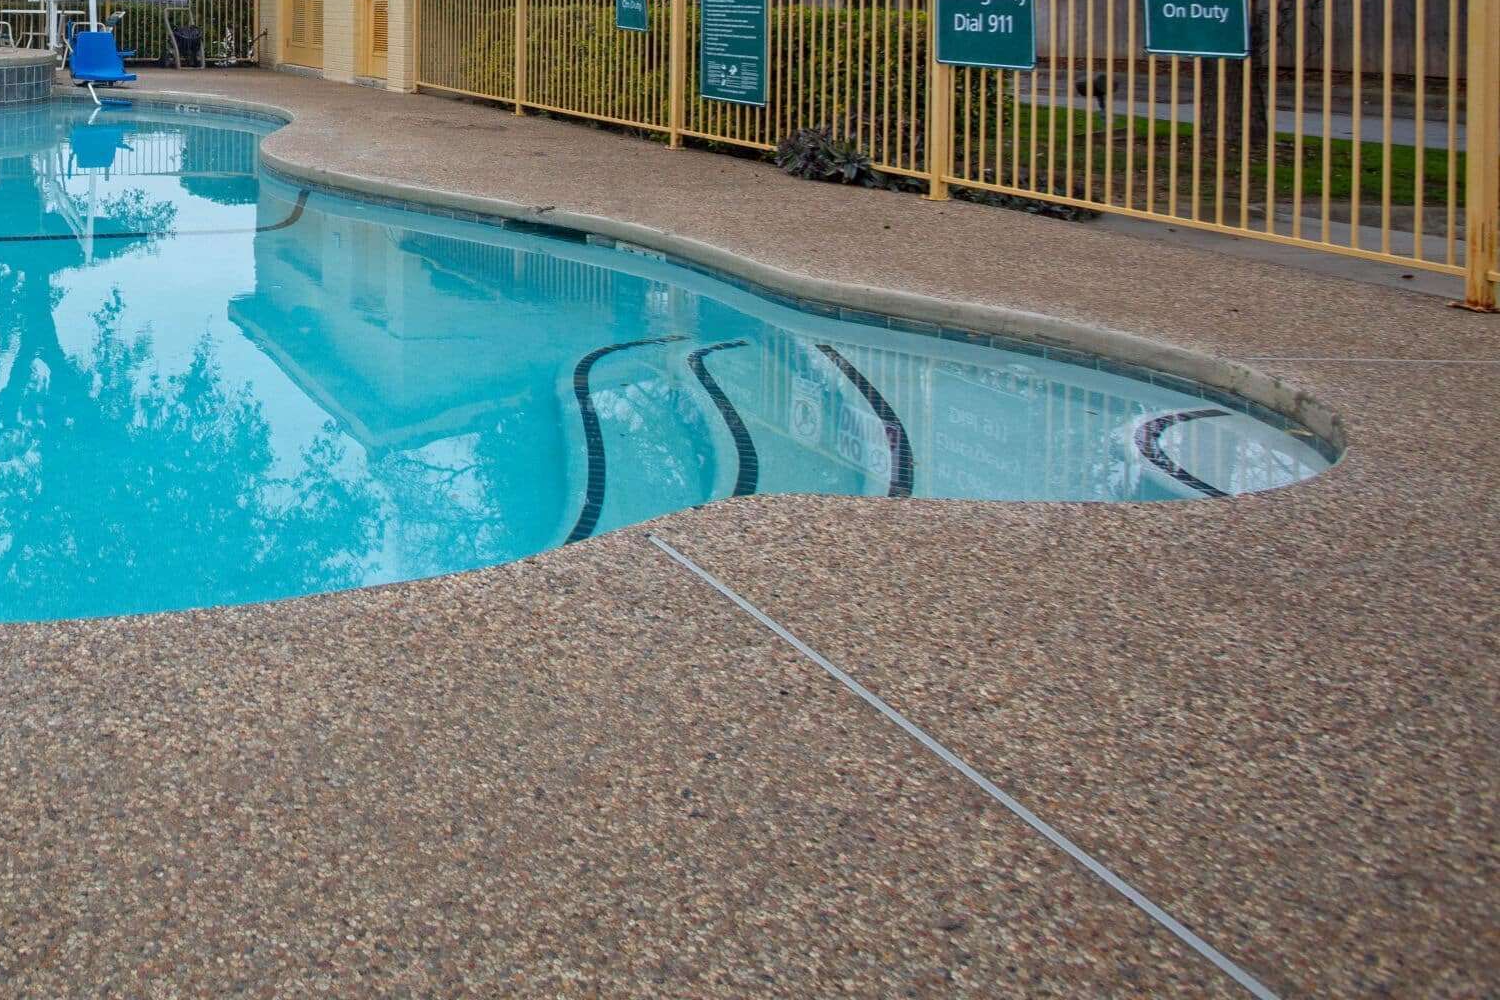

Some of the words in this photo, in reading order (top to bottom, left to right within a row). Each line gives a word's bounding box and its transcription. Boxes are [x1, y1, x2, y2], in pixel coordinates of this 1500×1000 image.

[1162, 3, 1187, 18] On
[1189, 3, 1229, 22] Duty
[954, 13, 983, 32] Dial
[988, 14, 1013, 33] 911
